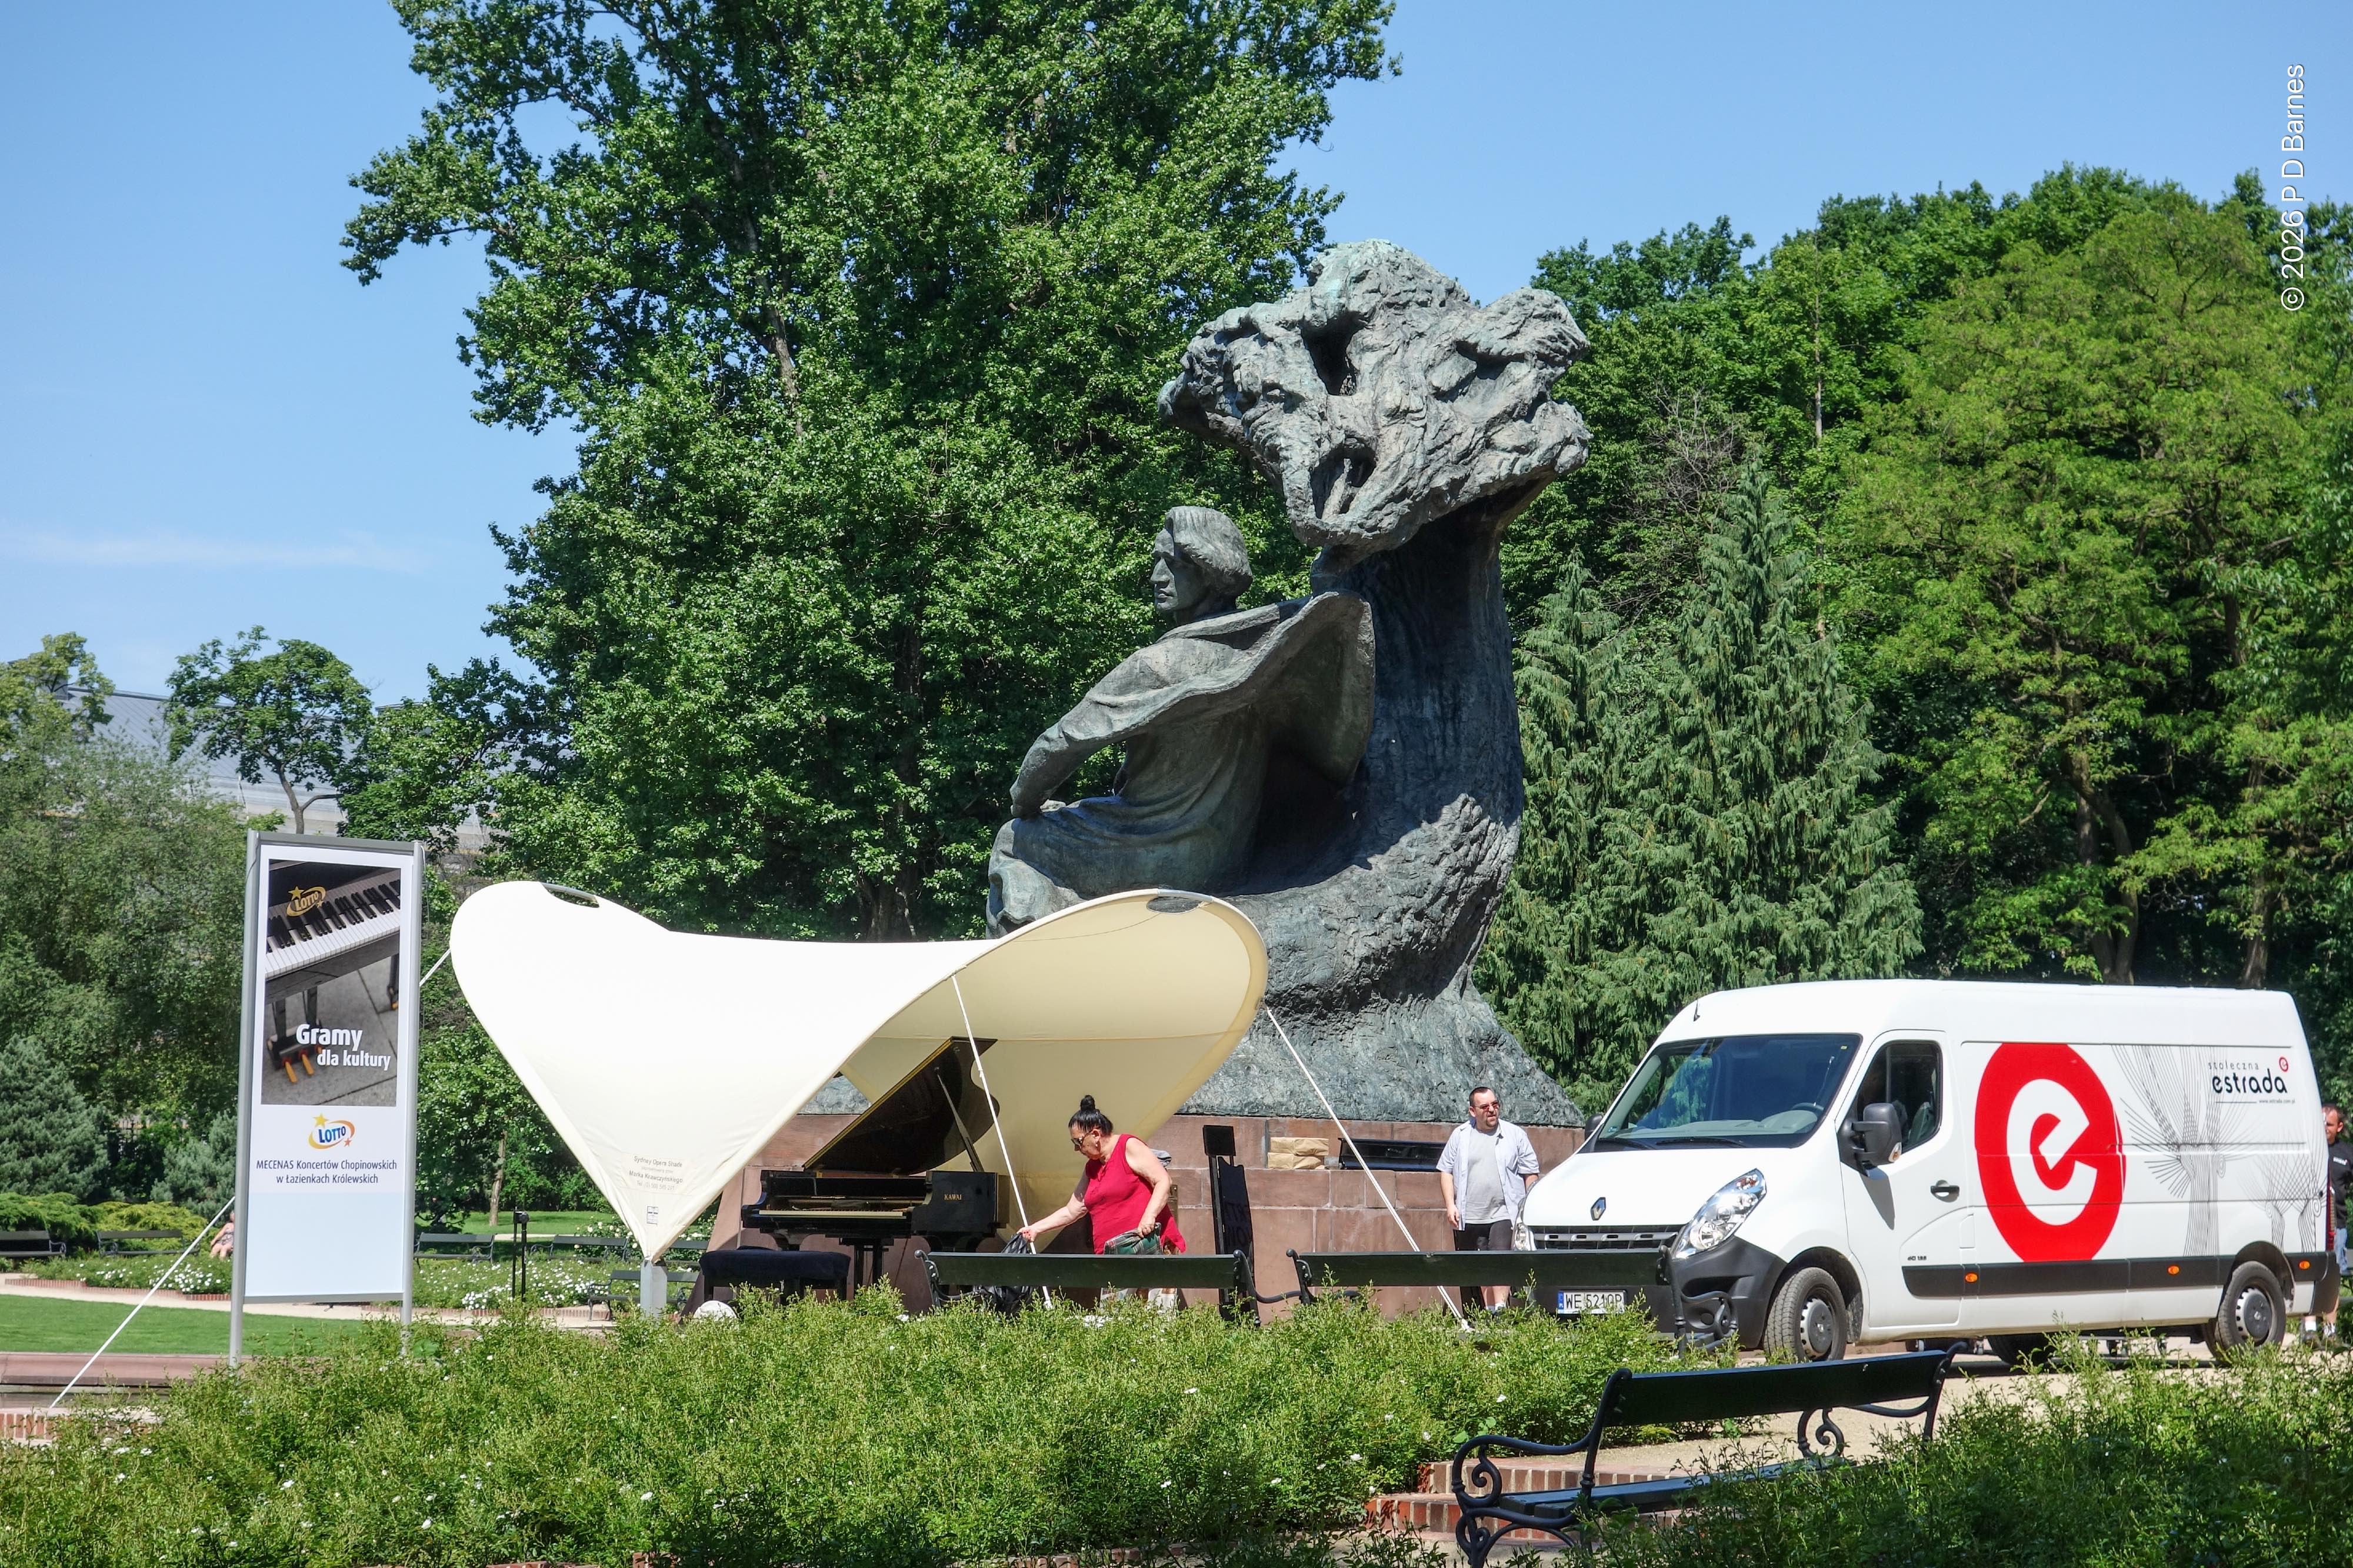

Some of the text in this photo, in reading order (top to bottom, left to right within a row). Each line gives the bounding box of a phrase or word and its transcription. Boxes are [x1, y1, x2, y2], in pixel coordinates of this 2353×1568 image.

[294, 892, 319, 911] LOTTO
[296, 1023, 363, 1052] Gramy
[316, 1049, 391, 1071] dla kultury
[2212, 1068, 2288, 1093] estrada
[318, 1126, 346, 1143] LOTTO
[2006, 1077, 2098, 1226] e
[256, 1159, 397, 1172] MECENAS Koncertów Chopinowskich
[634, 1156, 651, 1165] Sydney
[285, 1174, 329, 1184] Łazienkach
[332, 1174, 378, 1184] Królewskich
[629, 1170, 644, 1178] Marka
[1565, 1293, 1582, 1309] WE
